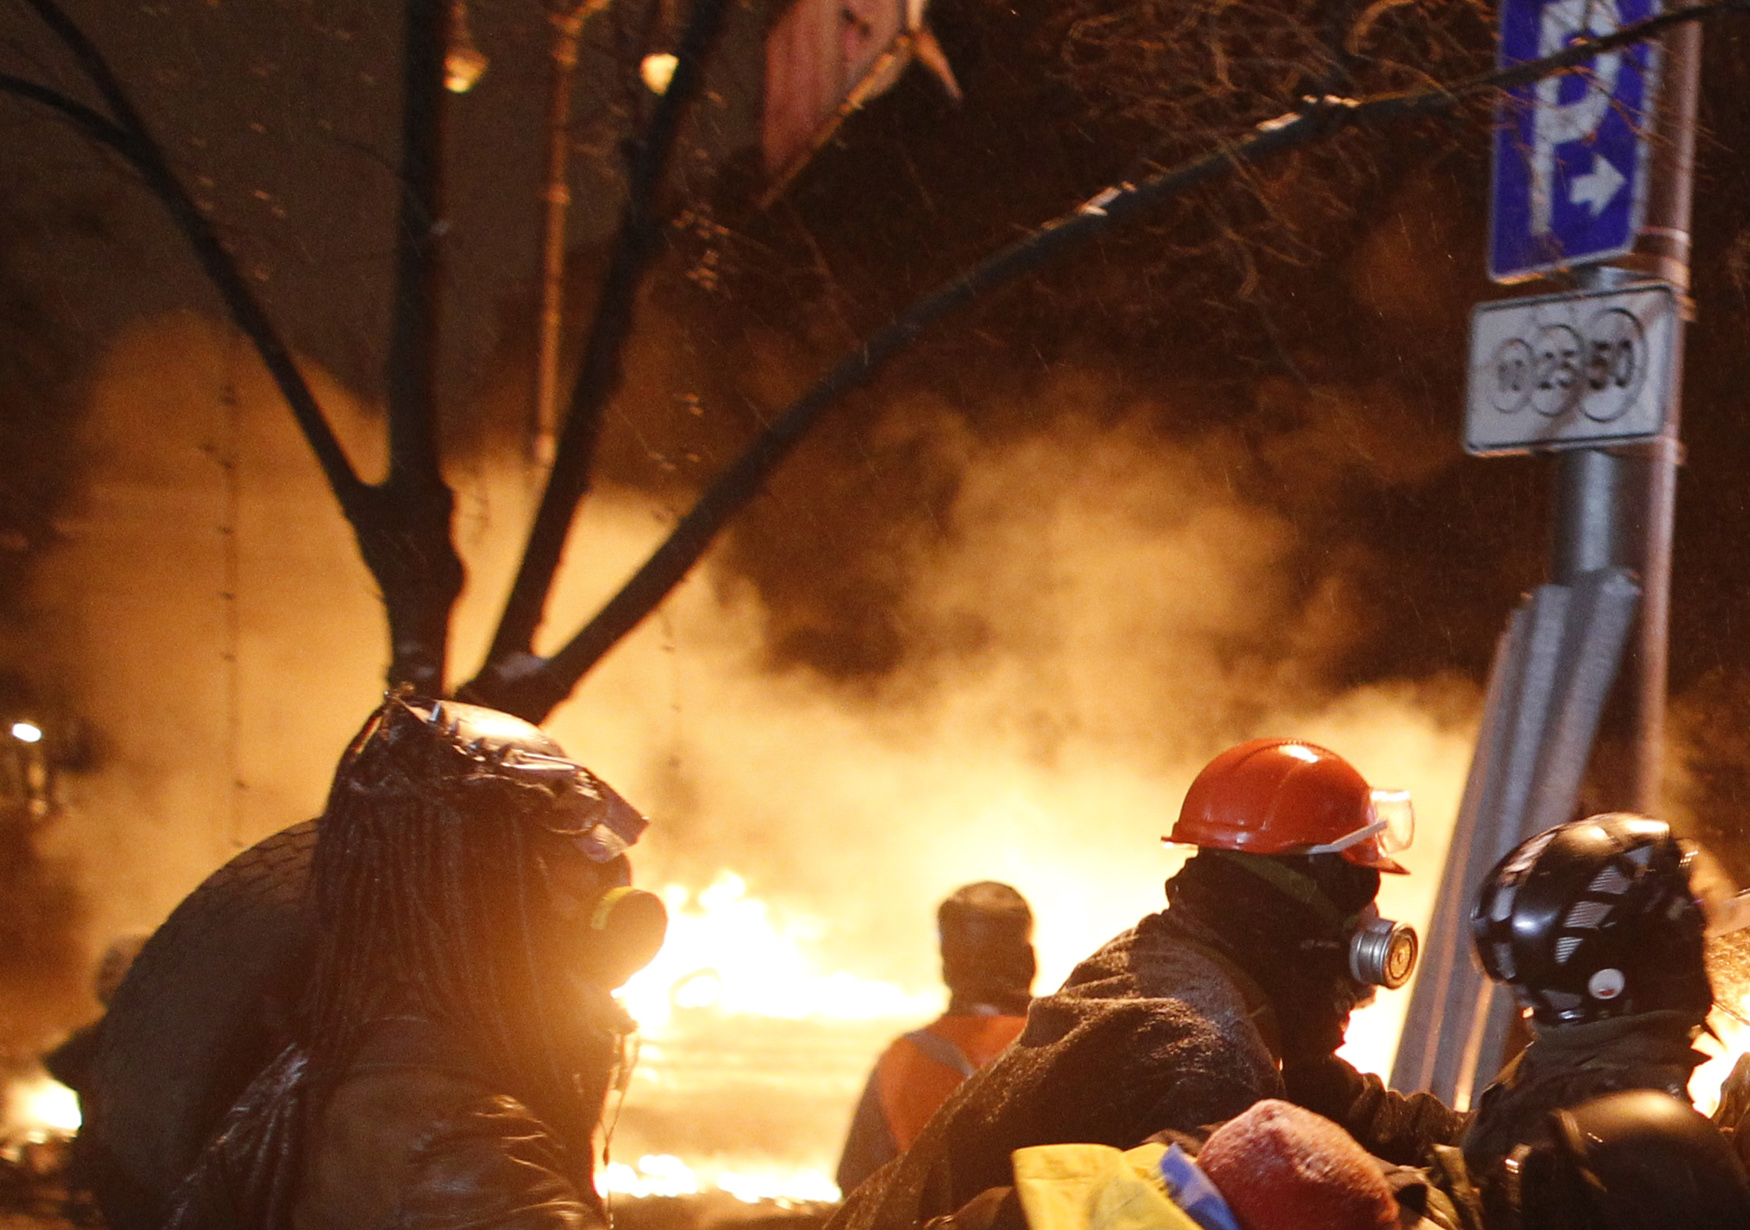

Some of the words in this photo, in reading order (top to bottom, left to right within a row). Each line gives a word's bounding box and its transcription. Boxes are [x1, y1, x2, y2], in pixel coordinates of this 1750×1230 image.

[1529, 0, 1623, 234] P
[1537, 350, 1577, 391] 25
[1588, 338, 1635, 392] 50
